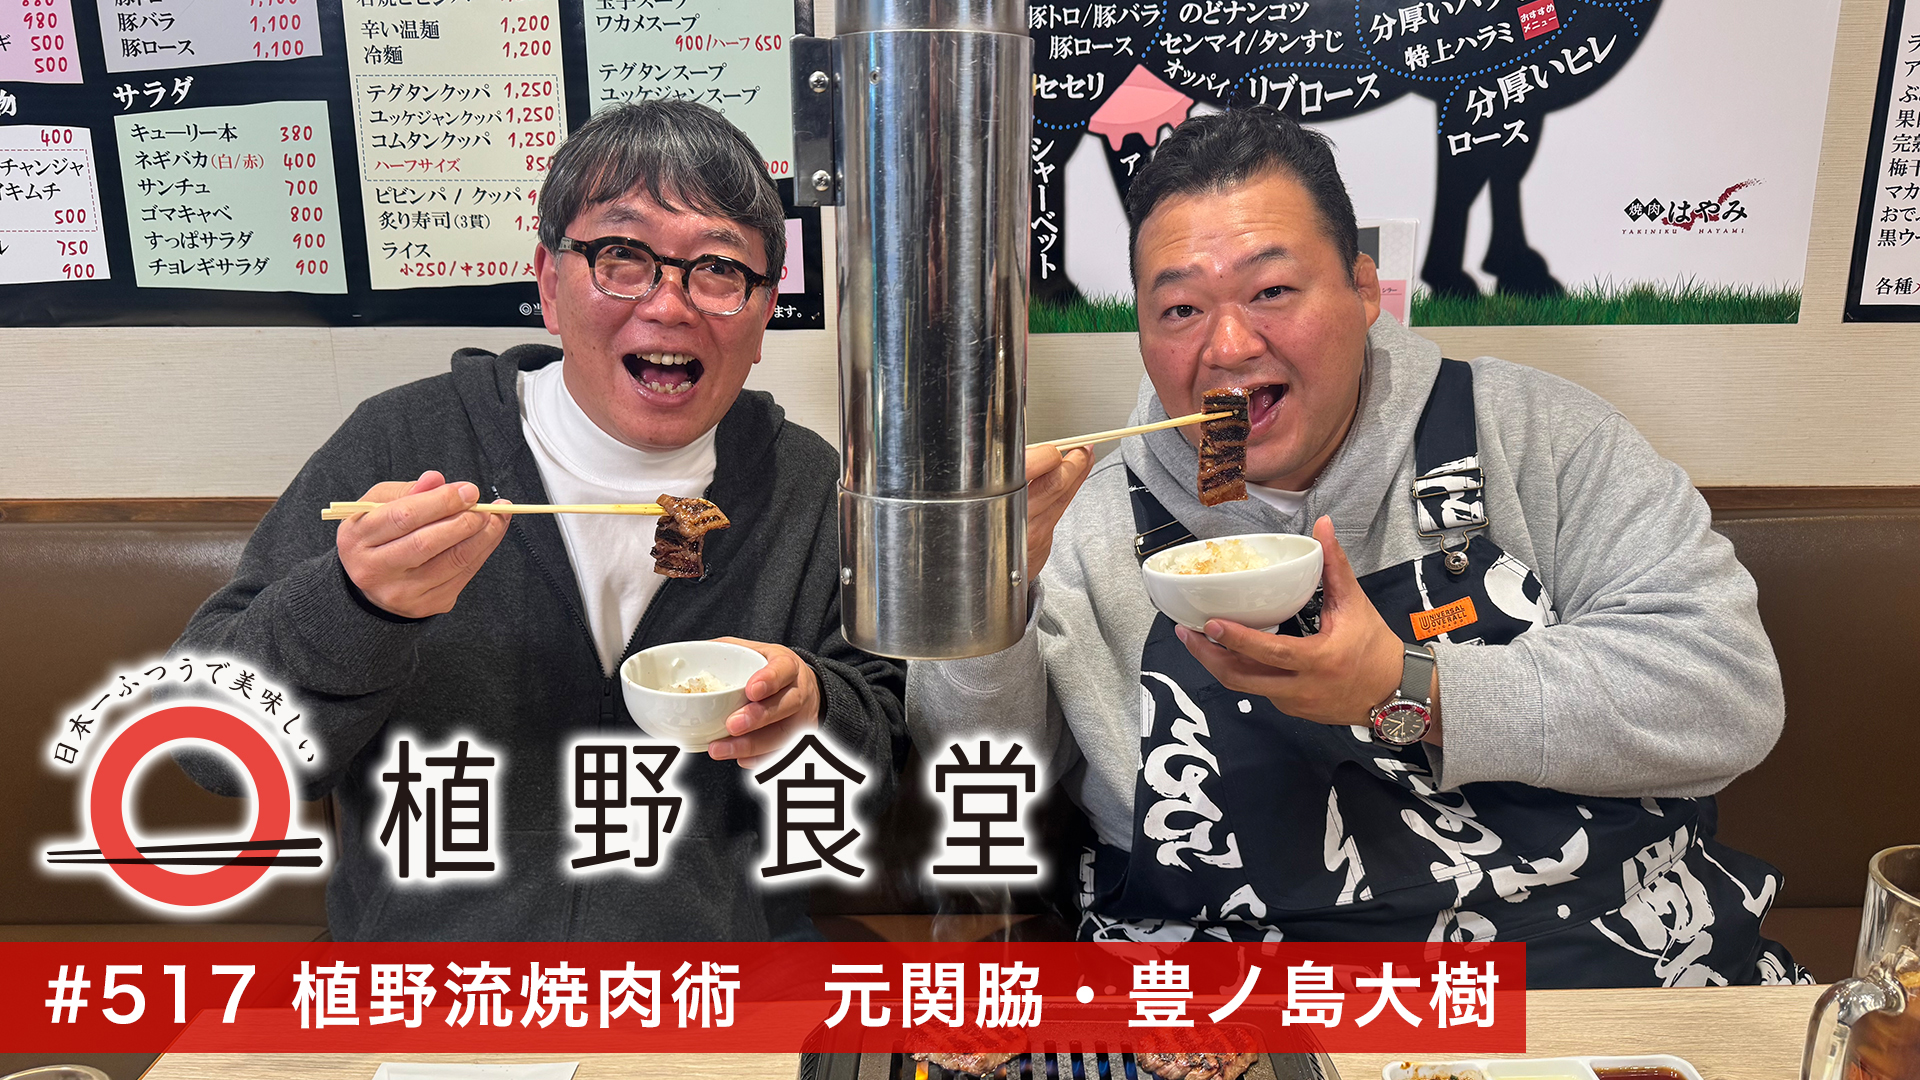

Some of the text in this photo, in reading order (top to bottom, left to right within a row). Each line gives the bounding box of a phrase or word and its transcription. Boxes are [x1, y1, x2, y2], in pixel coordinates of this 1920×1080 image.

[23, 12, 57, 29] 980
[117, 12, 175, 32] 豚バラ
[1179, 0, 1310, 25] のどナンコツ
[1519, 4, 1556, 23] おすすめ
[249, 14, 301, 33] 1,100
[360, 19, 440, 40] 辛い温麺
[500, 15, 550, 34] 1,200
[595, 13, 700, 33] ワカメスープ
[1523, 15, 1558, 34] メニュー
[31, 35, 64, 51] 500
[121, 37, 195, 58] 豚ロース
[252, 39, 304, 58] 1,100
[502, 39, 552, 58] 1,200
[1049, 34, 1134, 60] 豚ロース
[1159, 29, 1344, 55] センマイ/タンすじ
[1404, 22, 1514, 72] 特上ハラミ
[35, 57, 68, 73] 500
[598, 62, 727, 82] テグタンスープ
[1035, 72, 1105, 101] セセリ
[1163, 57, 1231, 98] オッパイ
[1465, 34, 1617, 125] 分厚いヒレ
[112, 75, 194, 110] サラダ
[366, 83, 491, 103] テグタンクッパ
[503, 80, 553, 99] 1,250
[600, 85, 761, 105] ユッケジャンスープ
[1249, 71, 1381, 116] リブロース
[1899, 84, 1920, 103] ぶ
[369, 109, 503, 127] ユッケジャンクッパ
[505, 105, 554, 124] 1,250
[1895, 109, 1920, 128] 果
[41, 128, 73, 146] 400
[280, 124, 313, 143] 380
[371, 130, 491, 150] コムタンクッパ
[507, 130, 556, 149] 1,250
[1447, 118, 1529, 156] ロース
[283, 152, 317, 171] 400
[374, 157, 461, 174] ハーフサイズ
[137, 177, 211, 196] サンチュ
[285, 179, 319, 197] 700
[471, 186, 522, 206] クッパ
[54, 208, 87, 225] 500
[141, 204, 233, 223] ゴマキャベ
[290, 206, 324, 223] 800
[1031, 137, 1058, 280] シャーベット
[1628, 200, 1748, 224] 焼肉 はやみ
[1880, 205, 1920, 223] おで
[144, 231, 254, 250] すっぱサラダ
[292, 233, 326, 250] 900
[1877, 228, 1920, 247] 黒ウ
[56, 240, 89, 256] 750
[382, 241, 431, 260] ライス
[62, 263, 95, 279] 900
[148, 257, 270, 276] チョレギサラダ
[295, 259, 329, 276] 900
